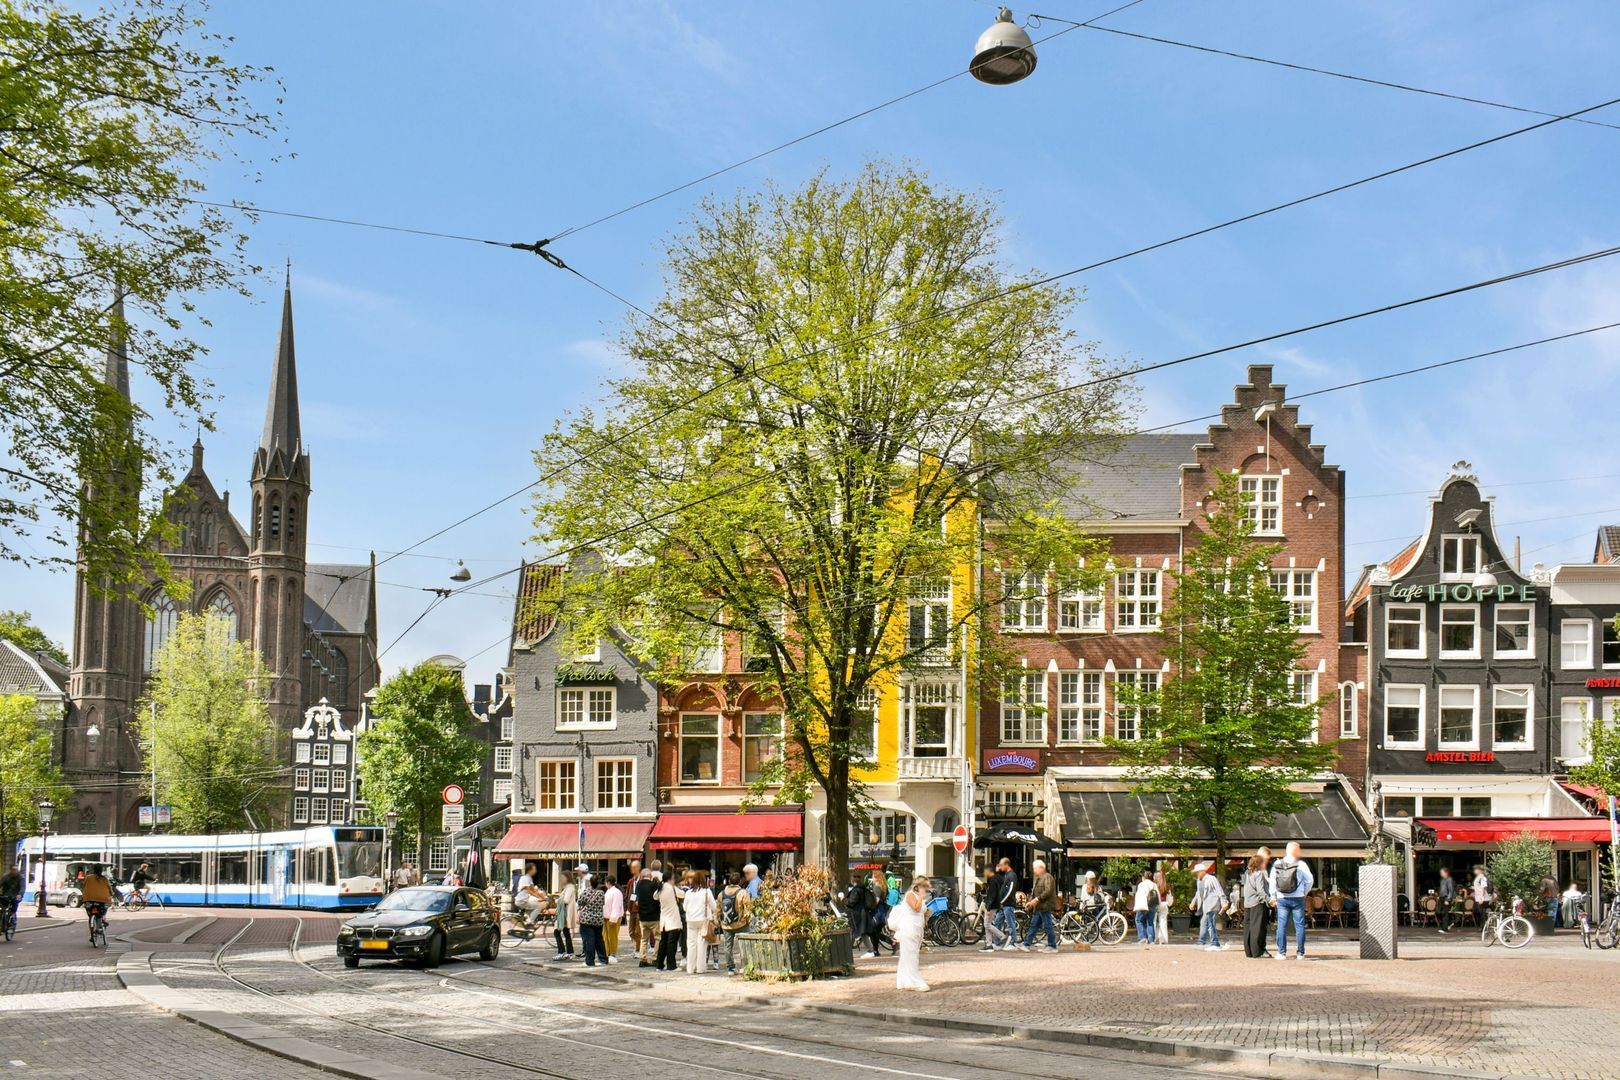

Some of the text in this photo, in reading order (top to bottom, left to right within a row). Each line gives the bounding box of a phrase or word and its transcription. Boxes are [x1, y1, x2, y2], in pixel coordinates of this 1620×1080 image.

[1389, 583, 1537, 602] Café HOPPE
[987, 754, 1037, 769] LUXEMBOURG
[1425, 752, 1495, 762] AMSTEL BIER
[659, 841, 698, 849] LAYERS
